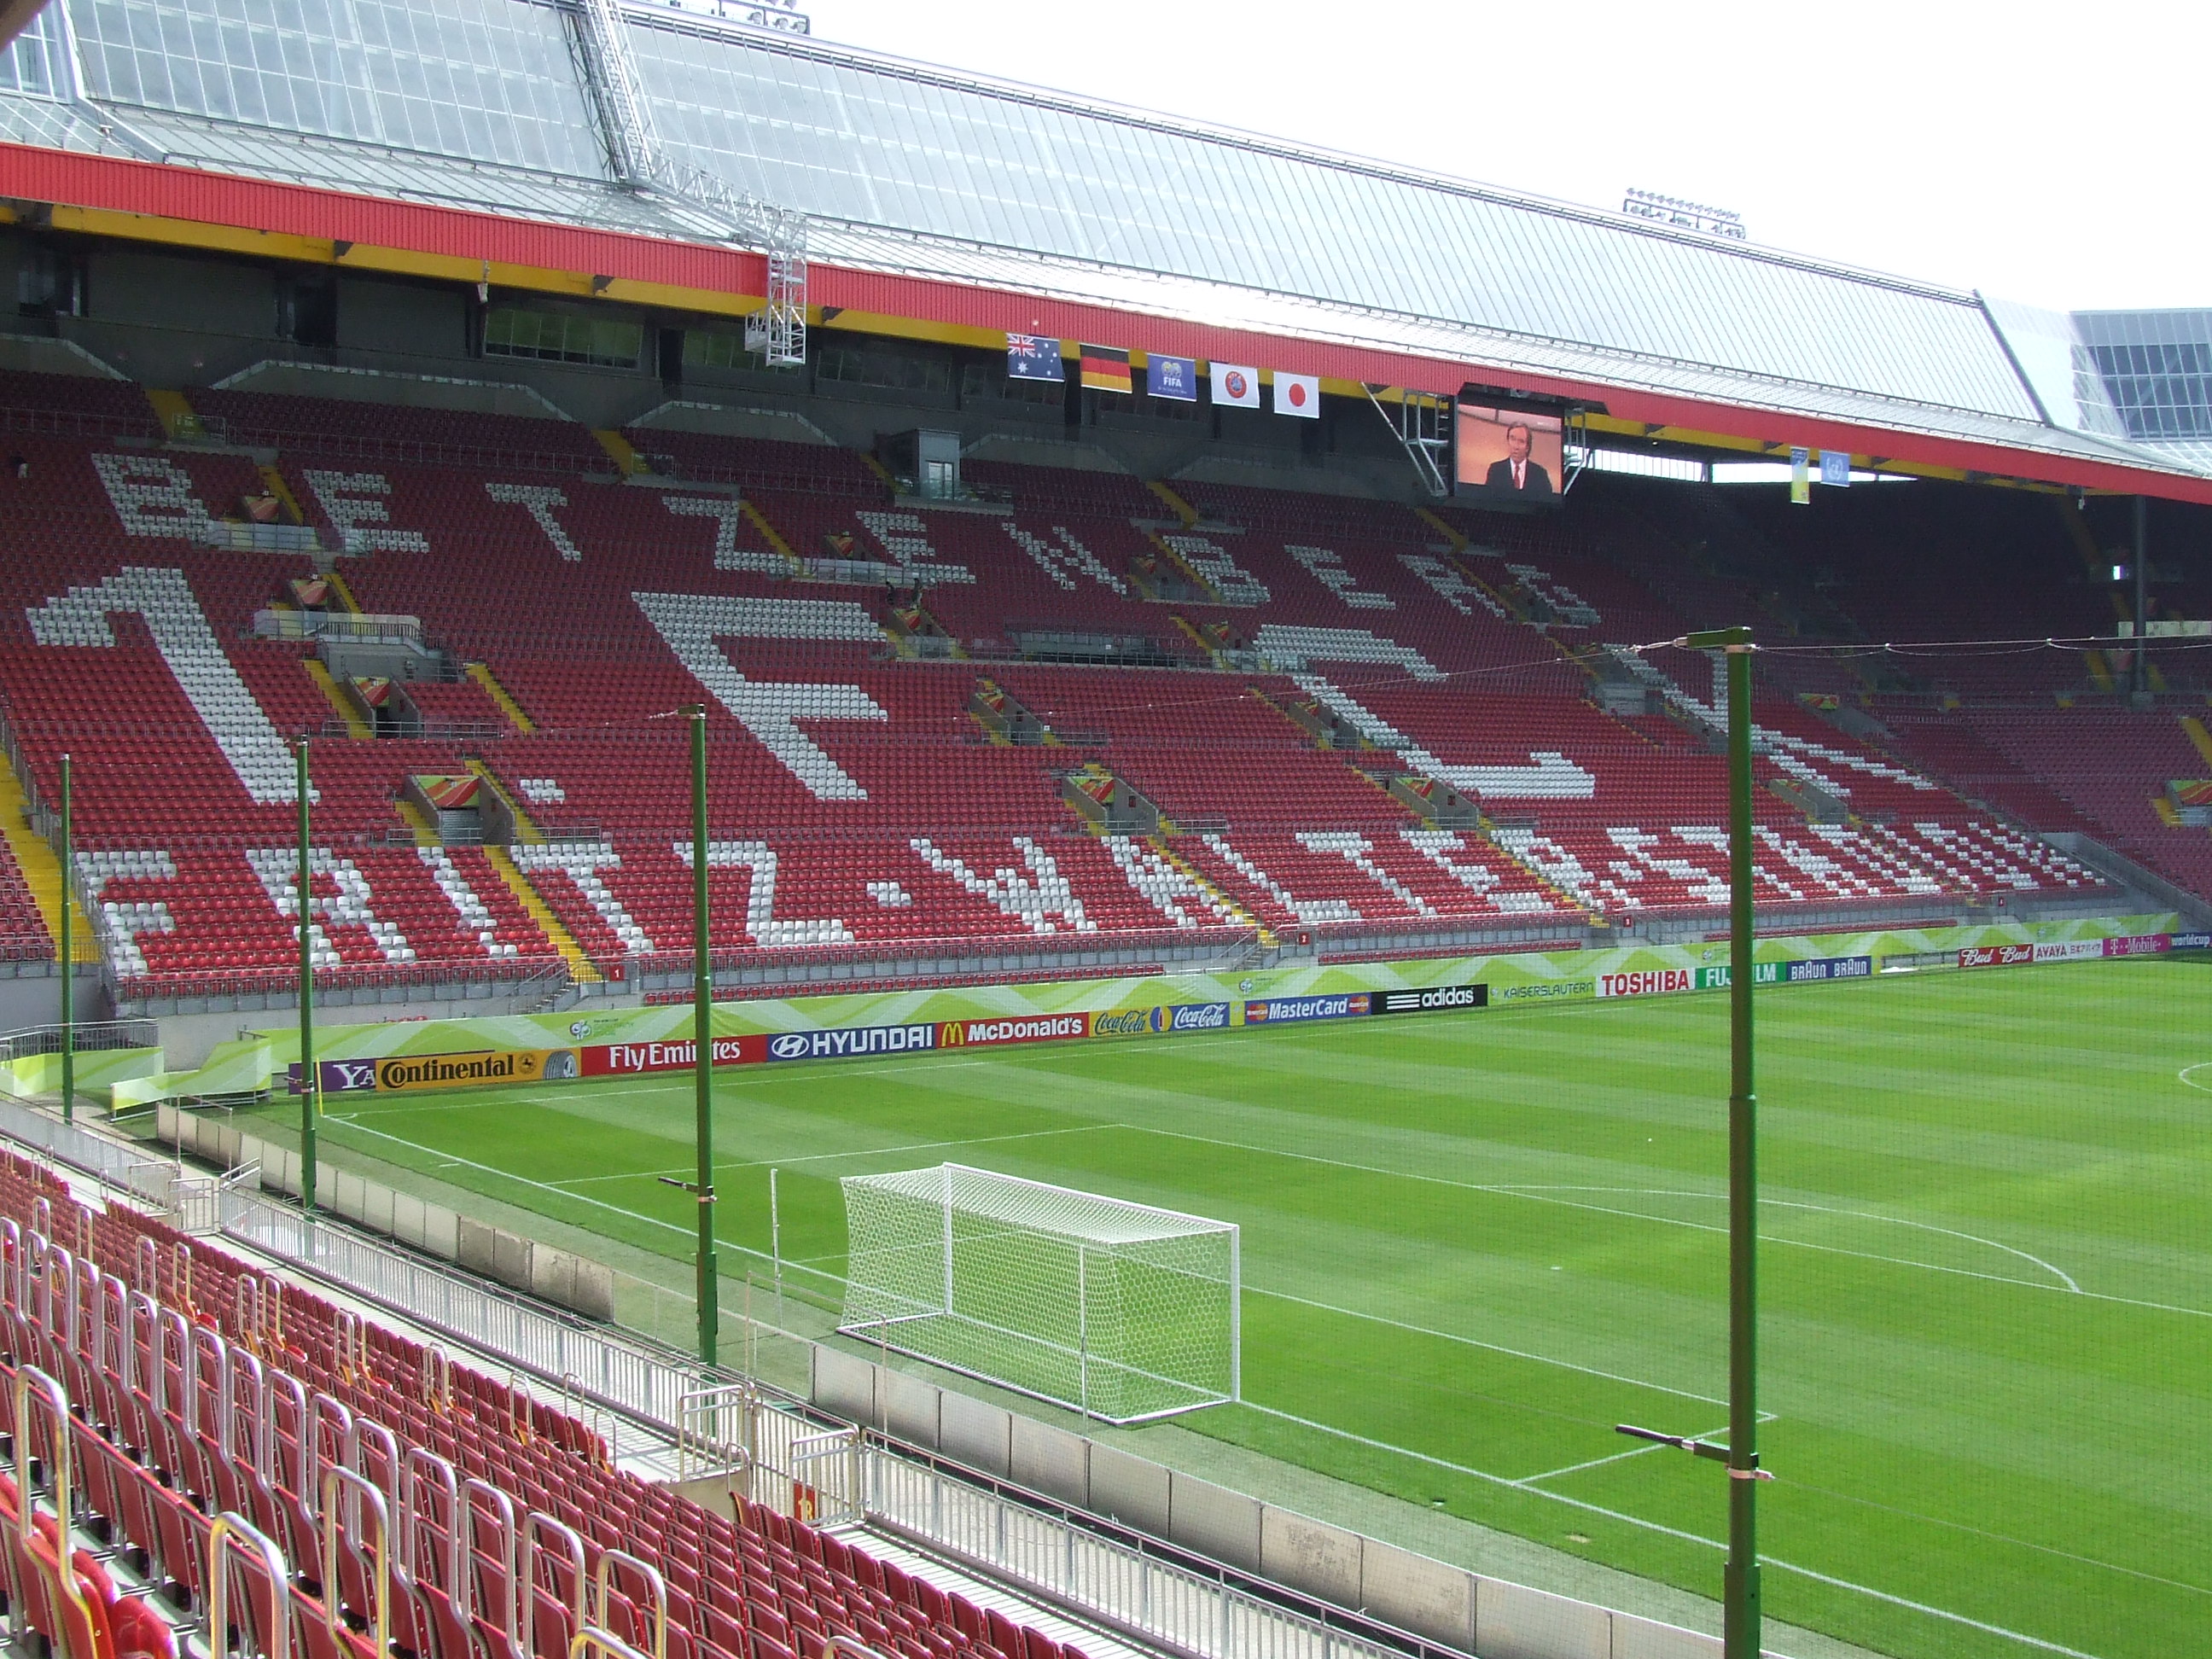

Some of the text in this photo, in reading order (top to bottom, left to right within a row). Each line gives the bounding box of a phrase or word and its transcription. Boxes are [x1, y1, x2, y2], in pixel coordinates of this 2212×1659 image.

[1163, 375, 1182, 387] FIFA
[1963, 946, 2031, 966] Bud Bud
[2036, 945, 2067, 958] AVAYA
[614, 969, 620, 978] 1
[1706, 963, 1776, 987] FULM
[1791, 958, 1867, 980] BRAUN BRAUN
[1504, 982, 1594, 999] KAISERSLAUTERN
[1601, 970, 1690, 996] TOSHIBA
[1422, 987, 1474, 1007] adidas
[1174, 1004, 1227, 1029] Coca-Cola
[1268, 998, 1348, 1020] MasterCard
[968, 1017, 1083, 1042] McDonald's
[812, 1026, 932, 1056] HYUNDAI
[609, 1040, 741, 1071] Fly Emites
[381, 1055, 514, 1089] Continental
